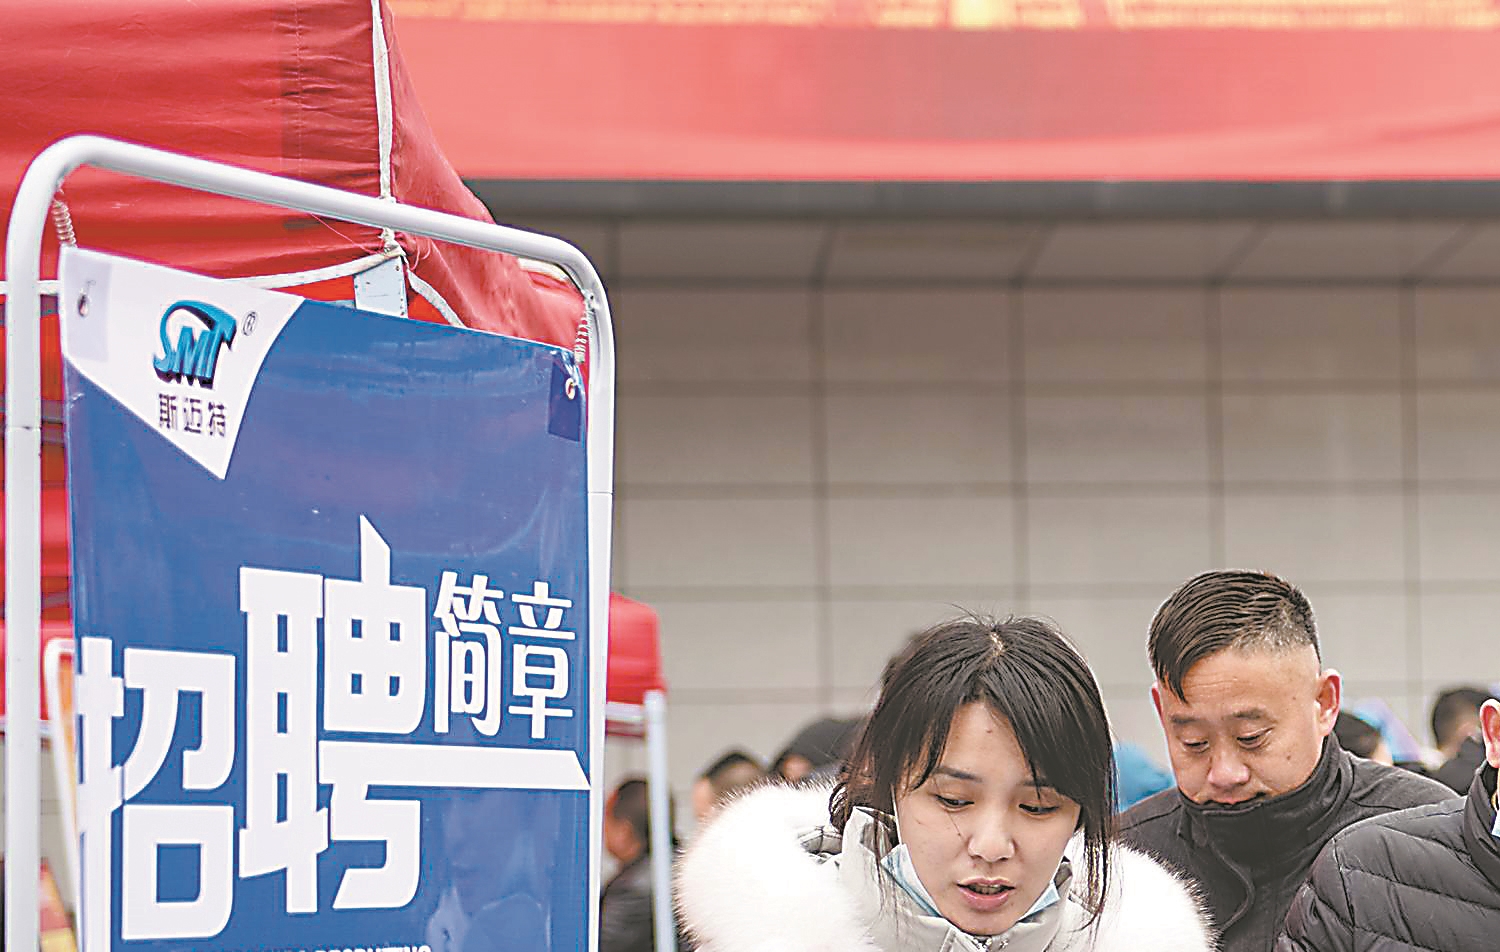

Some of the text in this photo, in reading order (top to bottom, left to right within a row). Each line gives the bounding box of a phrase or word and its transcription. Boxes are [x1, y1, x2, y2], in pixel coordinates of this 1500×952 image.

[158, 393, 226, 437] 斯迈特
[77, 515, 591, 940] 招聘 简章
